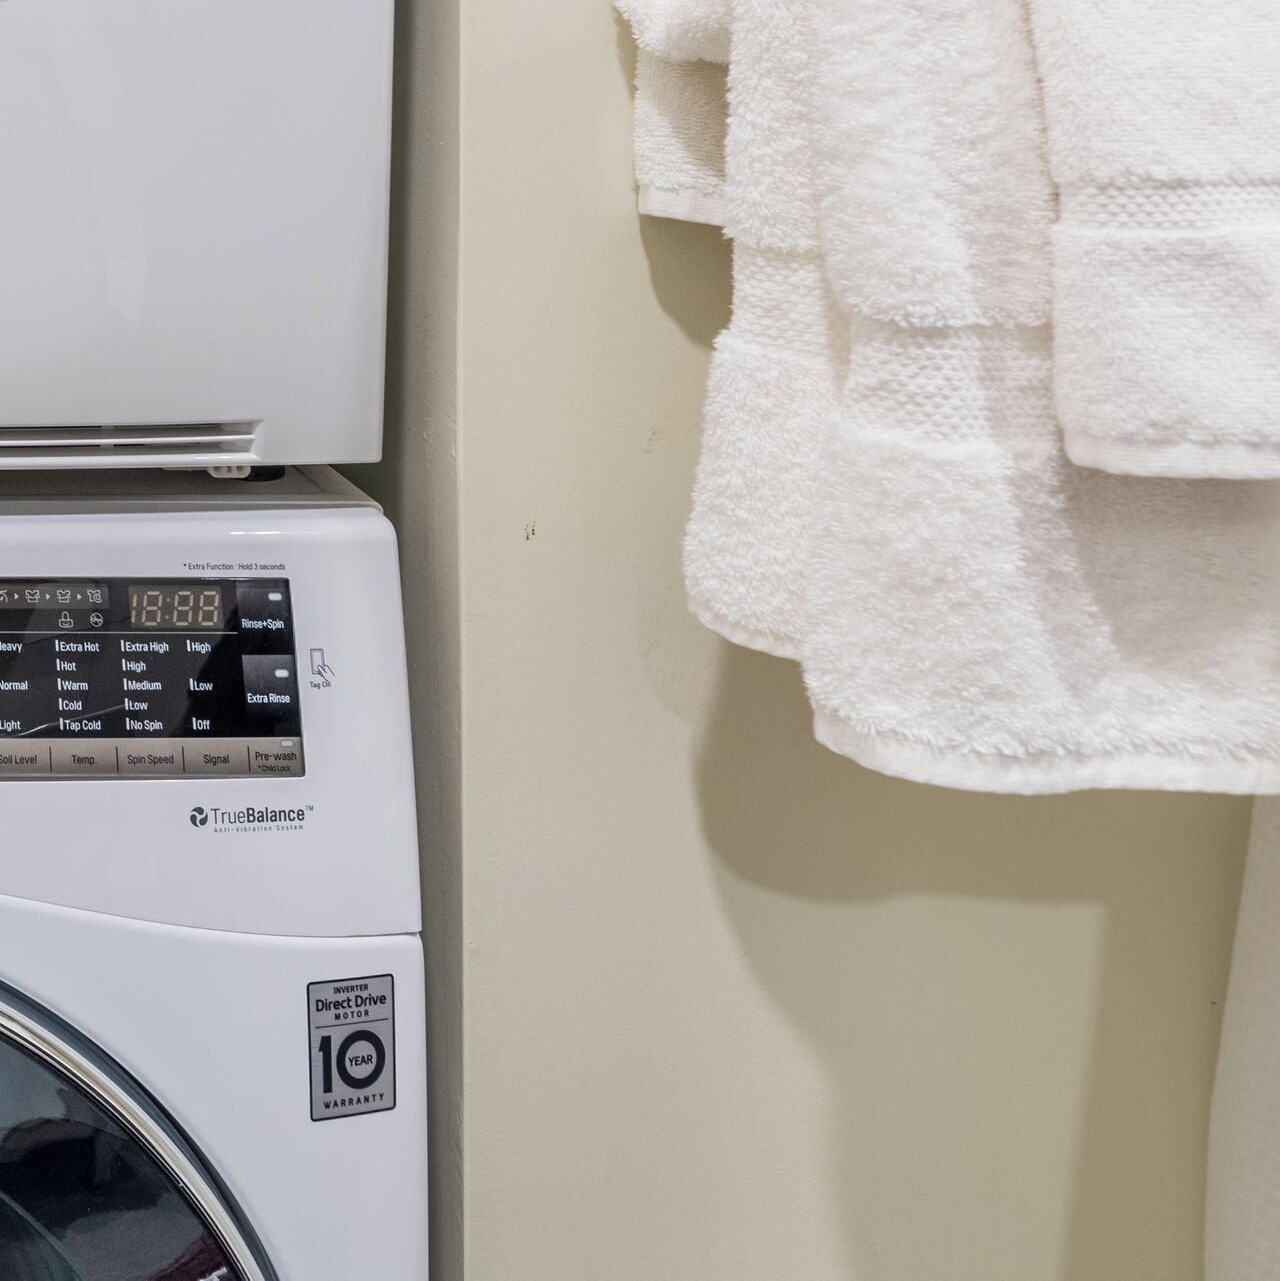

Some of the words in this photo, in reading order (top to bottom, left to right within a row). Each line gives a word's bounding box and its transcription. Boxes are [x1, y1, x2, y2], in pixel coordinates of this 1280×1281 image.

[188, 562, 206, 571] Extra
[206, 562, 234, 571] Function
[238, 562, 253, 571] Hold
[259, 562, 286, 571] seconds
[241, 619, 285, 630] Rinse+Spin
[60, 641, 83, 652] Extra
[84, 642, 100, 652] Hot
[125, 641, 148, 652] Extra
[149, 641, 169, 654] High
[191, 641, 212, 654] High
[60, 660, 77, 671] Hot
[126, 661, 147, 673] High
[62, 680, 89, 691] Warm
[128, 680, 162, 691] Medium
[194, 680, 213, 691] Low
[309, 681, 321, 690] Tag
[247, 693, 268, 703] Extra
[269, 693, 290, 703] Rinse
[63, 700, 82, 711] Cold
[129, 700, 148, 710] Low
[65, 720, 81, 732] Tap
[82, 720, 102, 730] Cold
[130, 720, 143, 730] No
[143, 720, 163, 732] Spin
[197, 719, 211, 730] Off
[14, 754, 38, 765] Level
[127, 754, 146, 767] Spin
[147, 754, 175, 767] Speed
[203, 754, 230, 767] Signal
[255, 751, 297, 762] Pre-wash
[210, 806, 305, 825] TrueBalance
[213, 824, 273, 833] Anti-Vibration
[276, 824, 304, 832] System
[333, 983, 369, 995] INVERTER
[315, 997, 353, 1013] Direct
[355, 993, 387, 1009] Drive
[334, 1009, 370, 1021] MOTOR
[318, 1029, 386, 1094] 10
[348, 1054, 374, 1067] YEAR
[323, 1092, 385, 1110] WARRANTY
